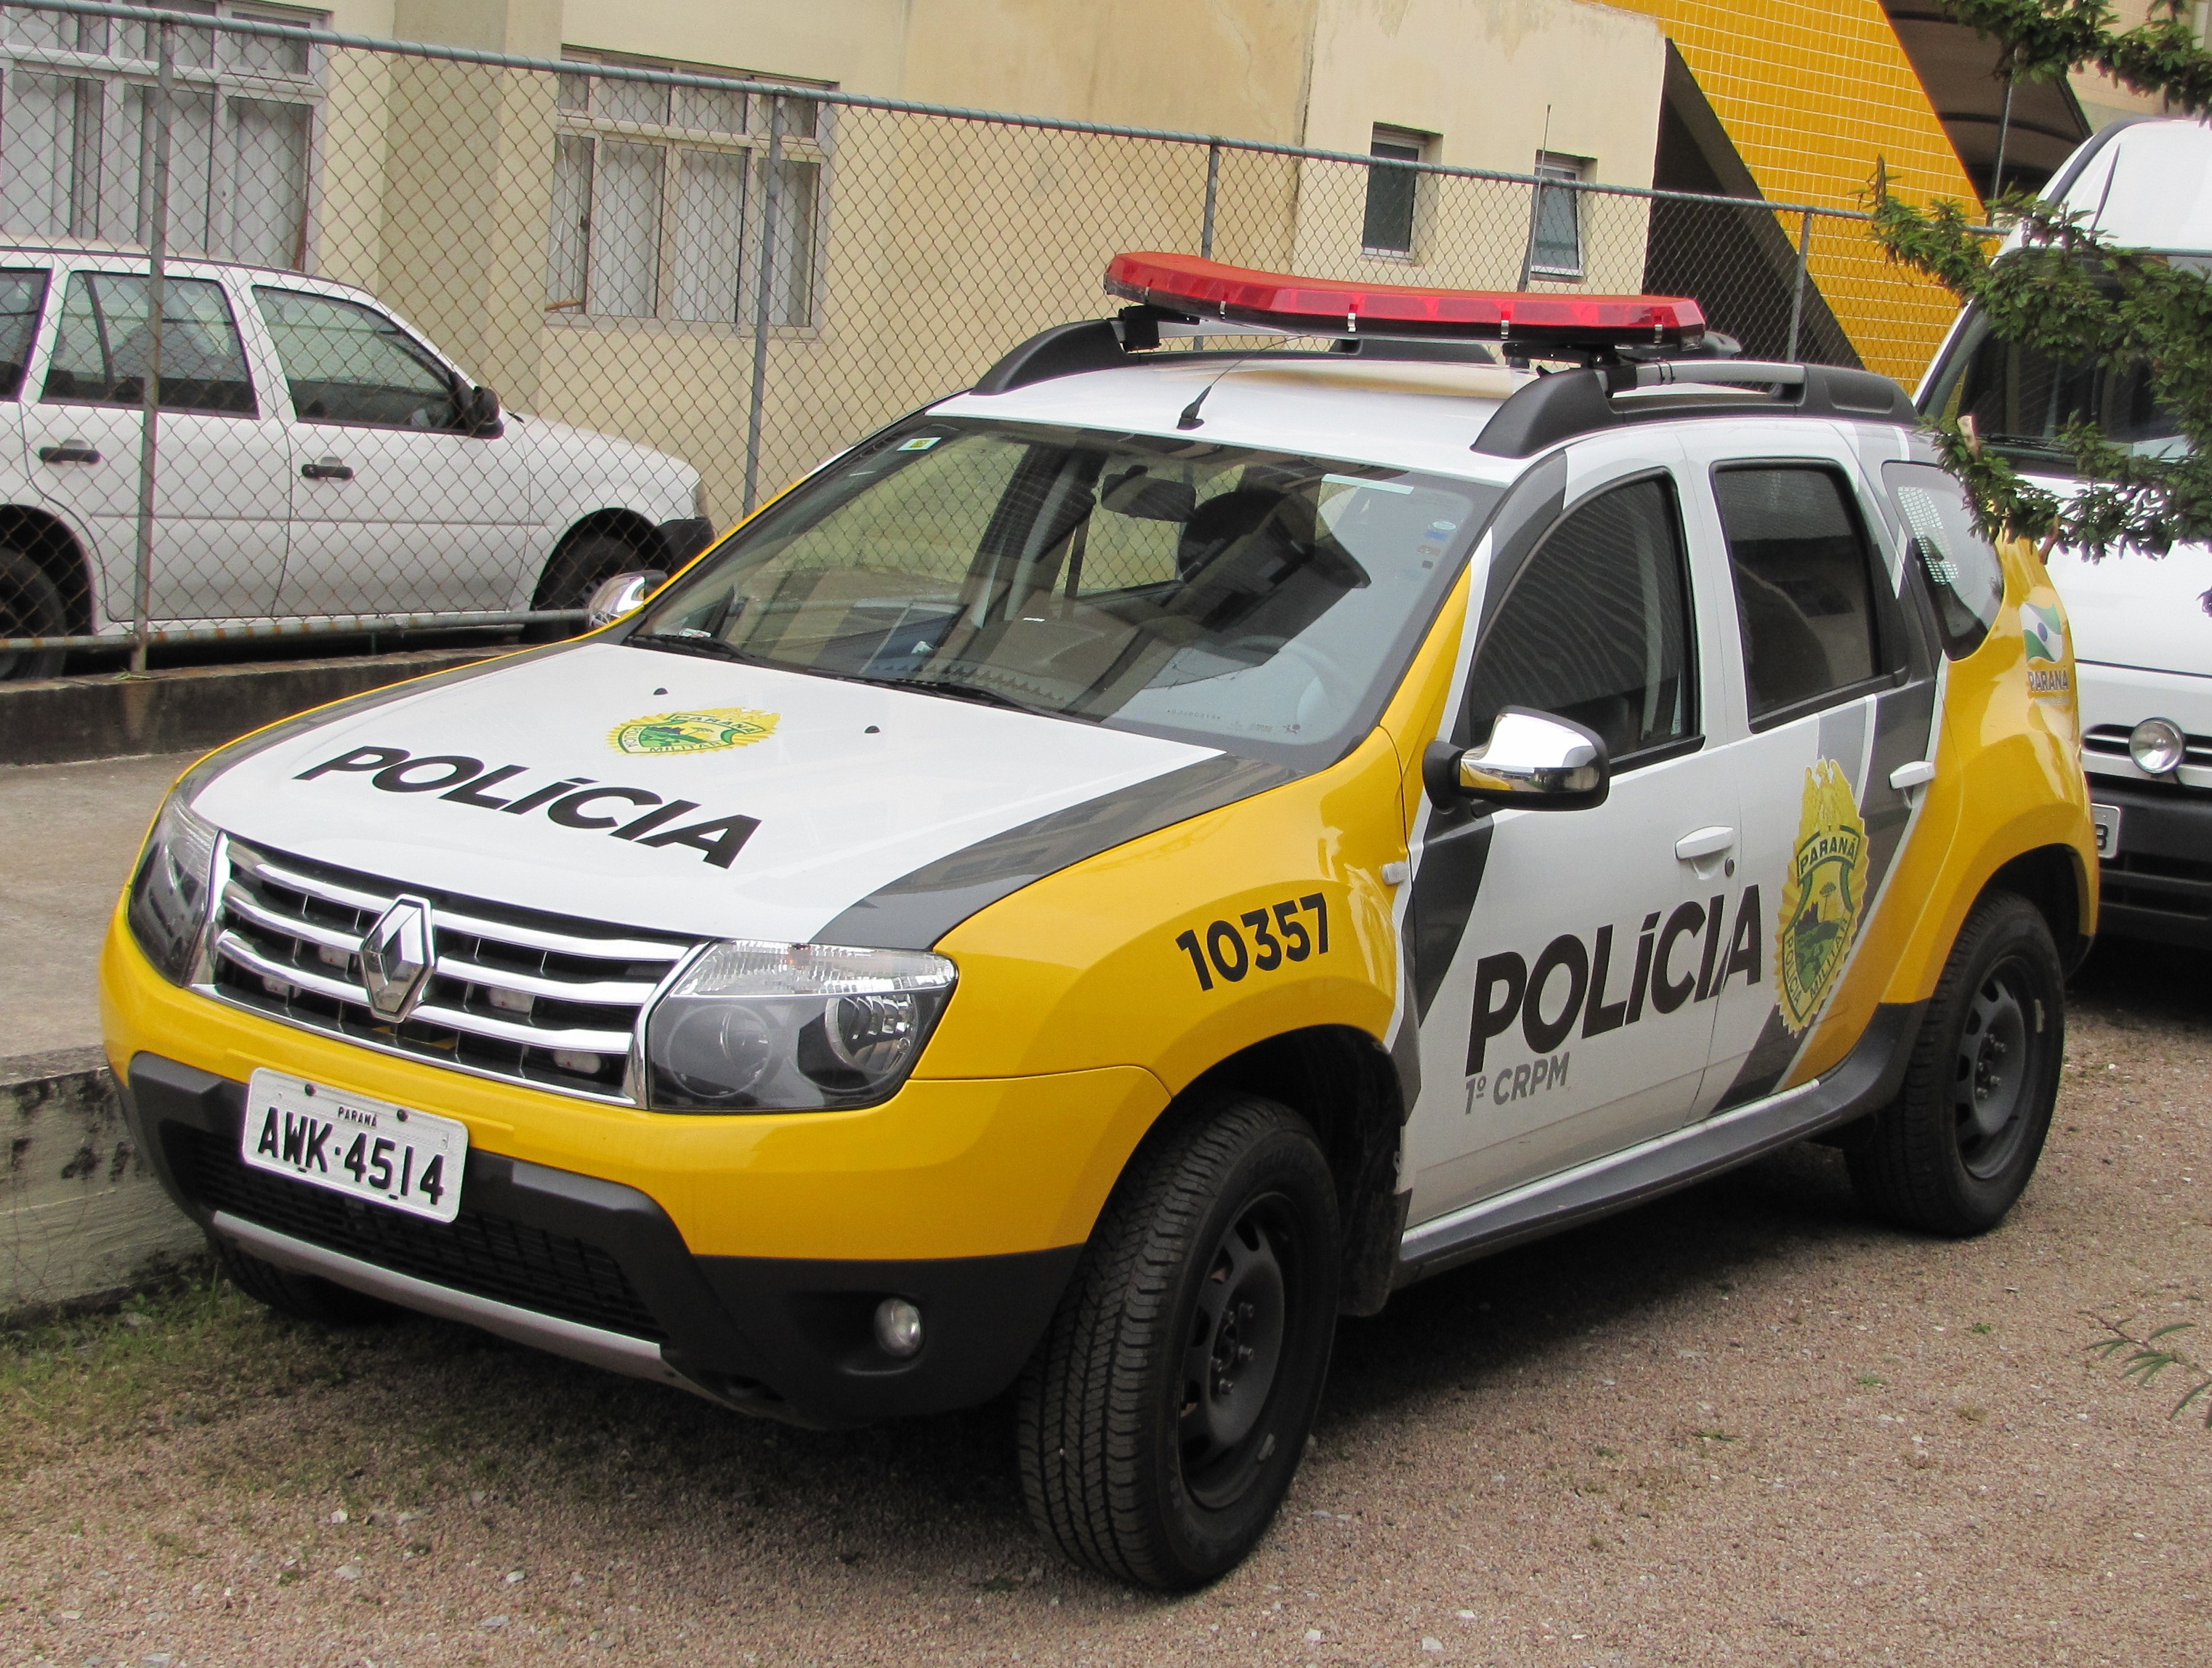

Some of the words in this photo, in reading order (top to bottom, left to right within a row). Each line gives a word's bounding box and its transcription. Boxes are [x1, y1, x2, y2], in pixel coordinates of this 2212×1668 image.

[2028, 664, 2069, 690] PARANÁ
[291, 746, 763, 869] POLÍCIA
[1799, 836, 1855, 875] PARANÁ
[1175, 892, 1328, 991] 10357
[1466, 884, 1761, 1076] POLÍCIA
[1493, 1051, 1570, 1105] CRPM
[338, 1105, 377, 1127] PARANÁ
